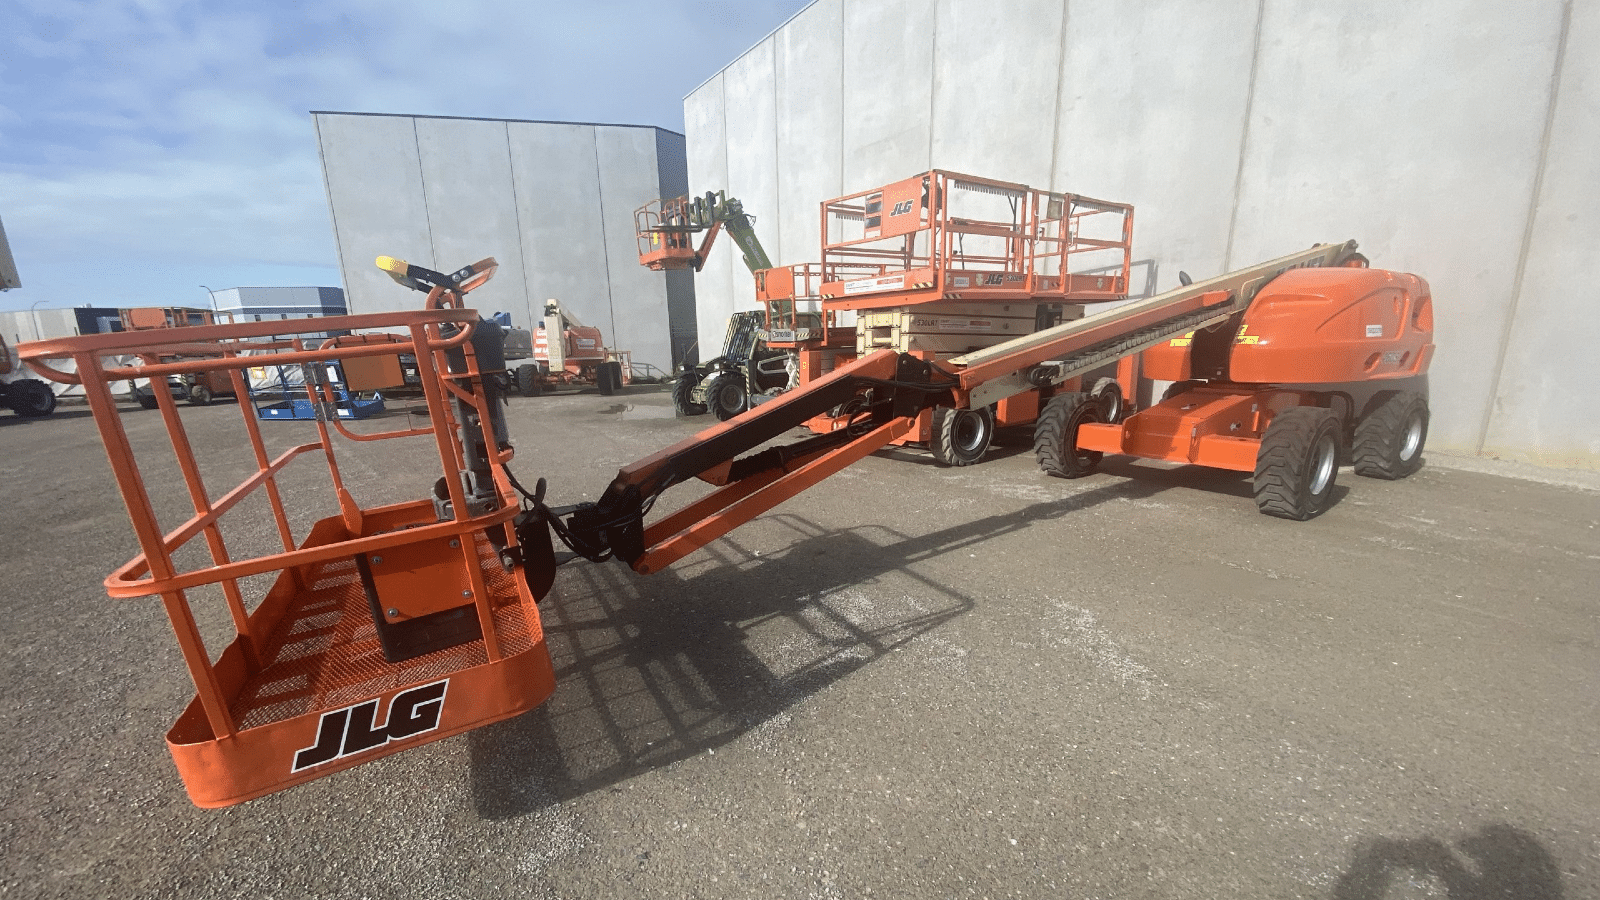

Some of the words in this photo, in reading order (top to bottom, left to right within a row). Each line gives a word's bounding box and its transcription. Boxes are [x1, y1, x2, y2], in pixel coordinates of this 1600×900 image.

[889, 199, 915, 217] JLG
[984, 273, 1003, 286] JLG
[291, 678, 450, 774] JLG
